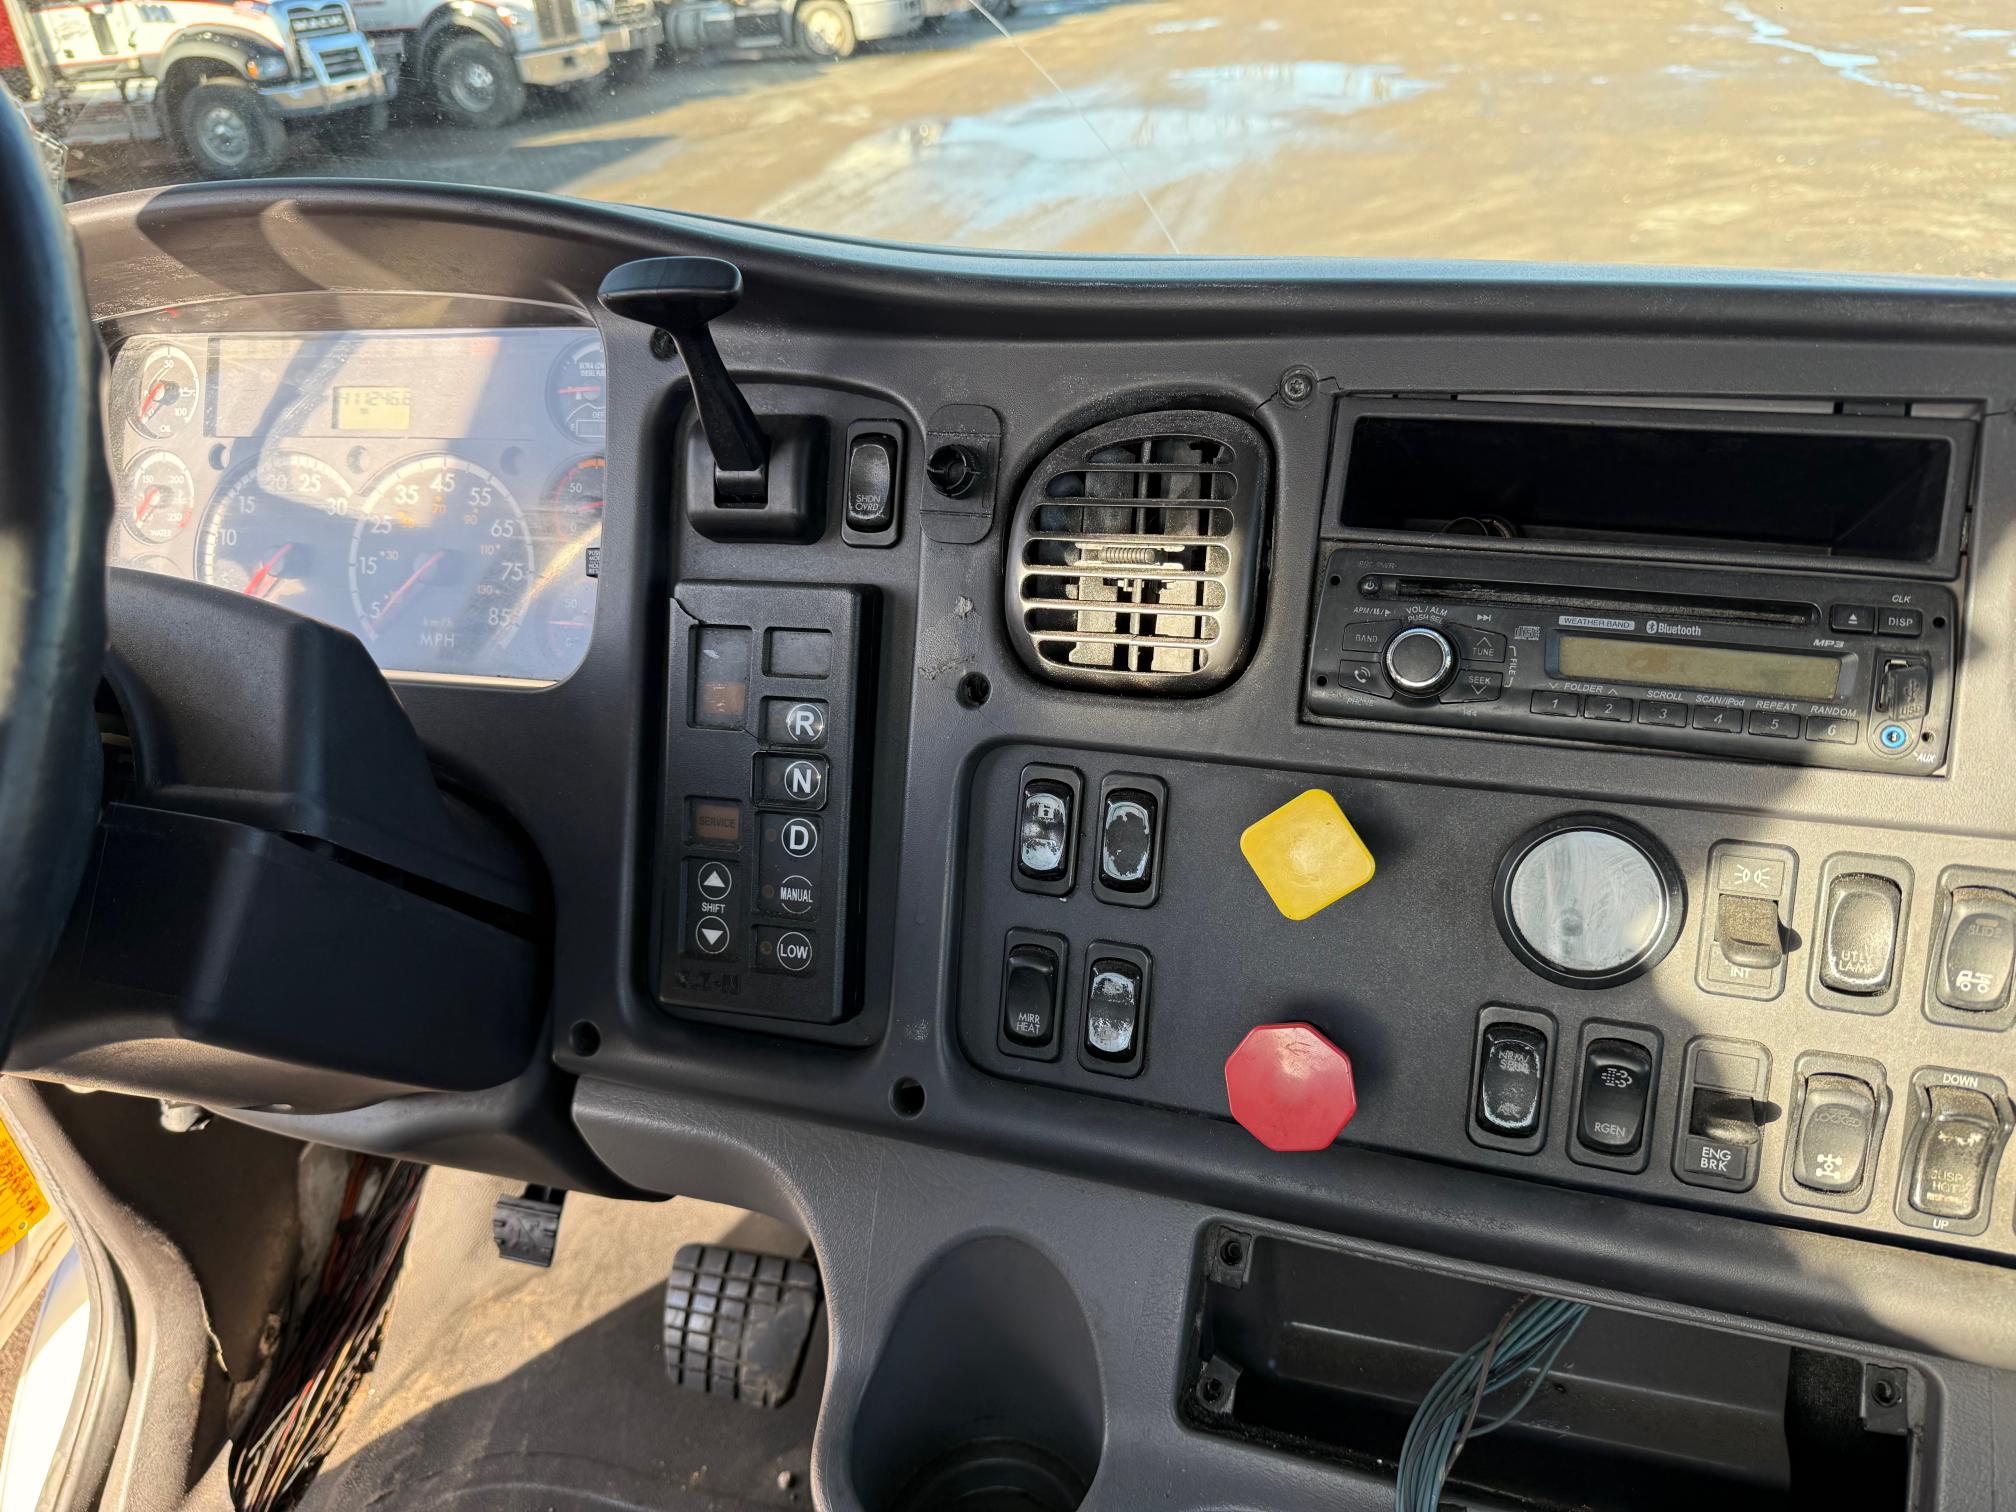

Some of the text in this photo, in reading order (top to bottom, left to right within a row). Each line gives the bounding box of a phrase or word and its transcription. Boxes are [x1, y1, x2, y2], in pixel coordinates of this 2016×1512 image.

[160, 424, 171, 433] OIL
[300, 473, 321, 492] 25
[430, 473, 456, 492] 45
[568, 482, 583, 493] 50
[395, 484, 420, 504] 35
[469, 487, 492, 506] 55
[855, 494, 881, 504] SHDN
[240, 495, 256, 514] 15
[327, 497, 348, 516] 30
[855, 502, 879, 511] OVRD
[371, 515, 393, 534] 25
[490, 519, 514, 537] 65
[150, 528, 173, 538] WATER
[220, 528, 238, 546] 10
[386, 550, 399, 561] 30
[360, 557, 378, 575] 15
[501, 561, 524, 581] 75
[1891, 594, 1912, 604] CLK
[369, 601, 381, 619] 5
[488, 607, 512, 626] 85
[1405, 605, 1424, 615] VOL
[1430, 606, 1448, 617] ALM
[1407, 614, 1445, 625] PUSH SEL
[1563, 617, 1631, 630] WEATHER BAND
[1888, 617, 1913, 627] DISP
[1657, 622, 1702, 637] Bluetooth
[420, 633, 455, 649] MPH
[1355, 634, 1378, 643] BAND
[1812, 638, 1845, 648] MP3
[1472, 647, 1495, 657] TUNE
[1508, 658, 1518, 676] FILE
[1468, 675, 1492, 686] SEEK
[1563, 682, 1604, 694] FOLDER
[1646, 690, 1684, 701] SCROLL
[1695, 694, 1746, 707] SCAN/iPod
[1551, 698, 1559, 709] 1
[1604, 703, 1613, 714] 2
[1755, 700, 1798, 712] REPEAT
[1901, 704, 1923, 716] USB
[1658, 708, 1668, 719] 3
[1810, 705, 1858, 718] RANDOM
[794, 710, 815, 737] R
[1713, 713, 1723, 725] 4
[1770, 718, 1780, 730] 5
[1827, 724, 1837, 736] 6
[1916, 752, 1936, 763] AUX
[792, 767, 812, 794] N
[698, 815, 738, 829] SERVICE
[789, 824, 810, 850] D
[780, 886, 814, 903] MANUAL
[701, 902, 726, 914] SHIFT
[1968, 924, 2002, 939] SLIDE
[779, 943, 809, 960] LOW
[1730, 966, 1752, 979] INT
[1018, 1011, 1041, 1025] MIRR
[1016, 1021, 1041, 1036] HEAT
[1942, 1073, 1979, 1088] DOWN
[1594, 1121, 1626, 1137] RGEN
[1701, 1146, 1732, 1161] ENG
[1700, 1157, 1727, 1172] BRK
[1932, 1217, 1950, 1230] UP
